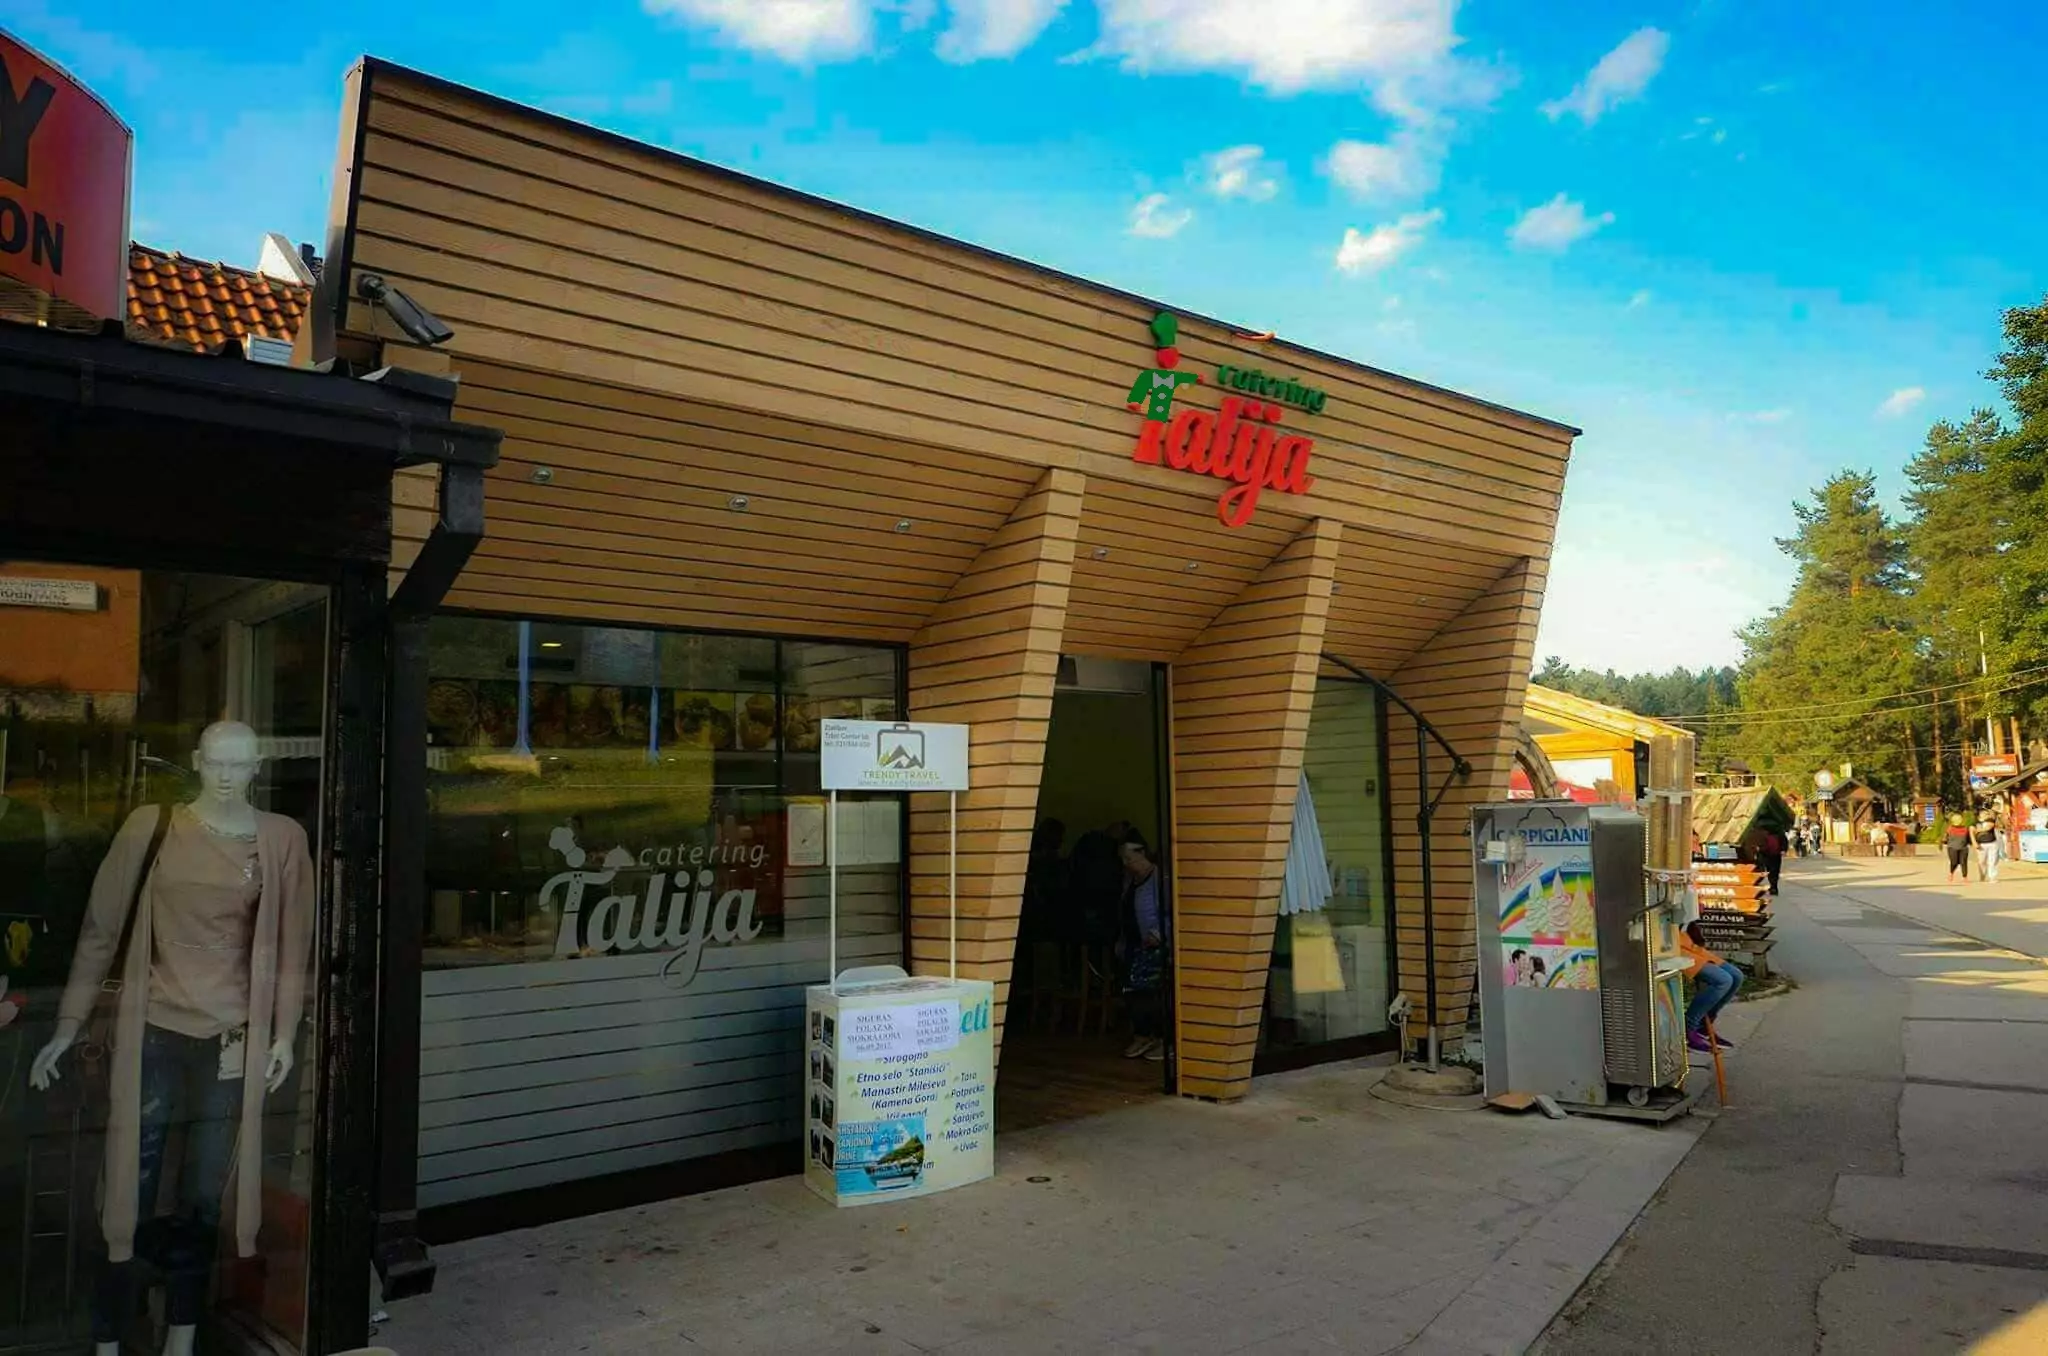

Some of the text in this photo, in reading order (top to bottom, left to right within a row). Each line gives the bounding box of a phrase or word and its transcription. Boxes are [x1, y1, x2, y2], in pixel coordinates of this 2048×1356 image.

[863, 770, 940, 780] TRENDY TRAVEL
[639, 838, 765, 868] catering
[1702, 914, 1745, 923] ОЛАЧИ
[539, 869, 763, 988] Talija
[1704, 928, 1745, 936] ЕЦИВА
[958, 998, 989, 1034] eti
[857, 1072, 881, 1083] Etno
[883, 1070, 902, 1081] selo
[961, 1072, 977, 1081] Tara
[861, 1085, 906, 1098] Manastir
[872, 1092, 938, 1110] (Kamena Gora)
[953, 1111, 985, 1125] Sarajevo
[946, 1128, 971, 1141] Mokra
[972, 1122, 989, 1134] Gora
[960, 1141, 978, 1152] Uvac
